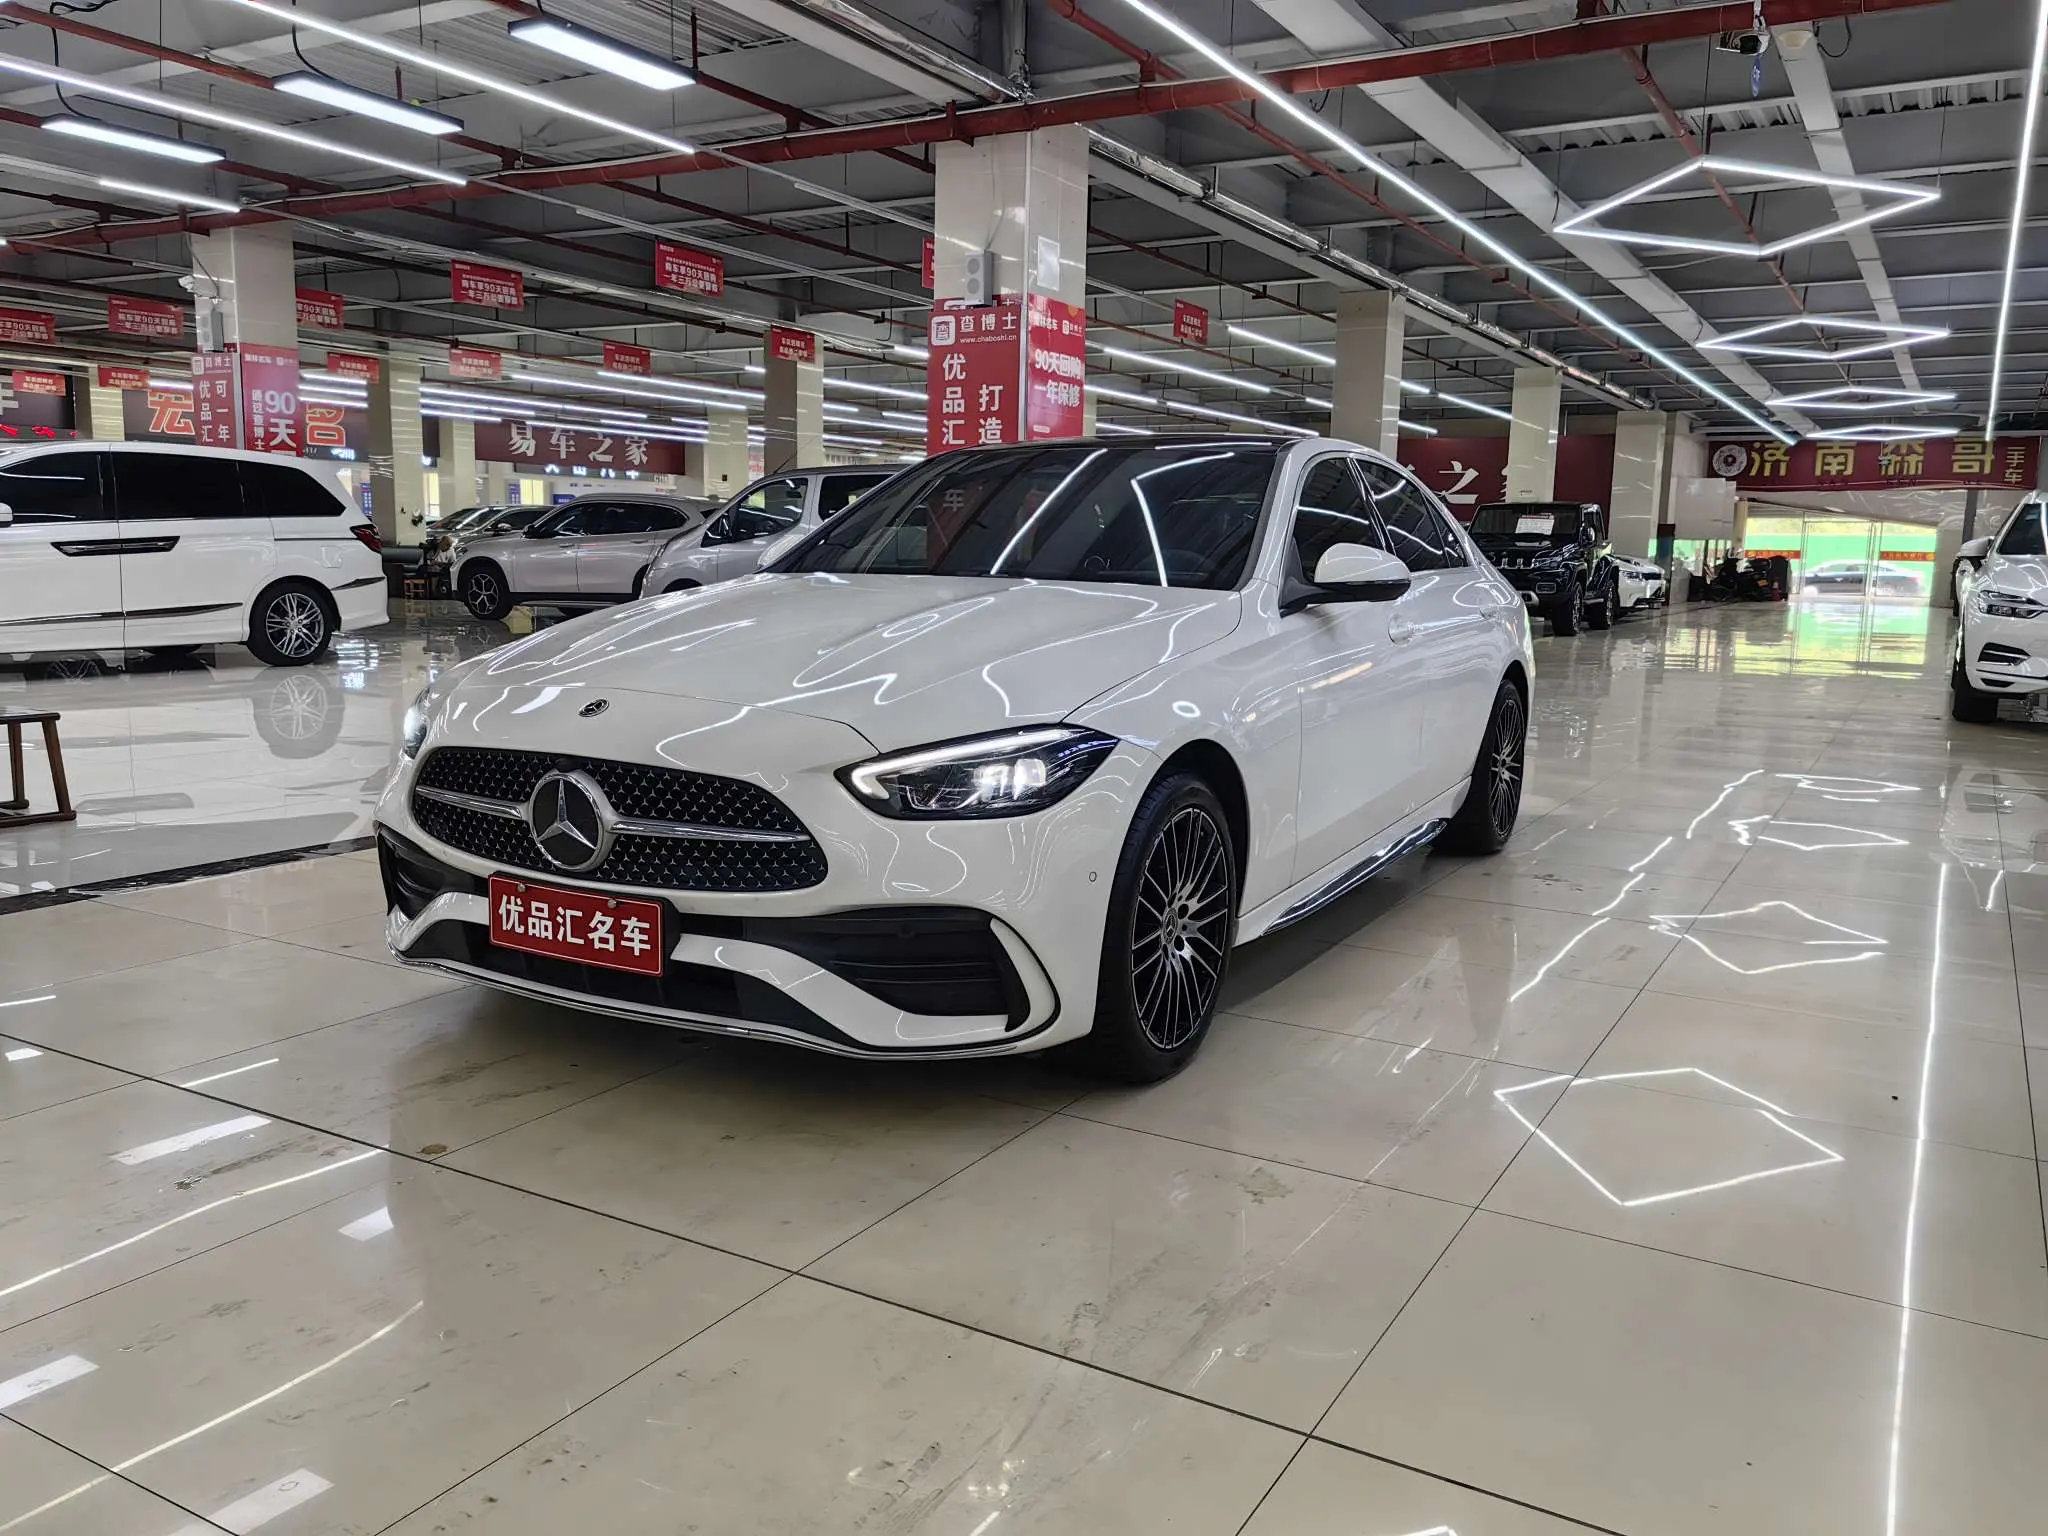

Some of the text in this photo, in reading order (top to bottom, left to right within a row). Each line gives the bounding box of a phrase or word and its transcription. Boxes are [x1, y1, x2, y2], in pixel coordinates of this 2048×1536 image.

[960, 312, 1017, 333] 查博士
[960, 334, 1017, 344] www.chaboshi.cn
[1035, 349, 1081, 380] 90天回购
[199, 380, 213, 442] 优品汇
[942, 354, 966, 445] 优品汇
[1034, 379, 1080, 408] 一年保修
[978, 384, 1003, 444] 打造
[508, 423, 649, 466] 易车之家
[2003, 446, 2026, 484] 二手车
[498, 893, 652, 956] 优品汇名车
